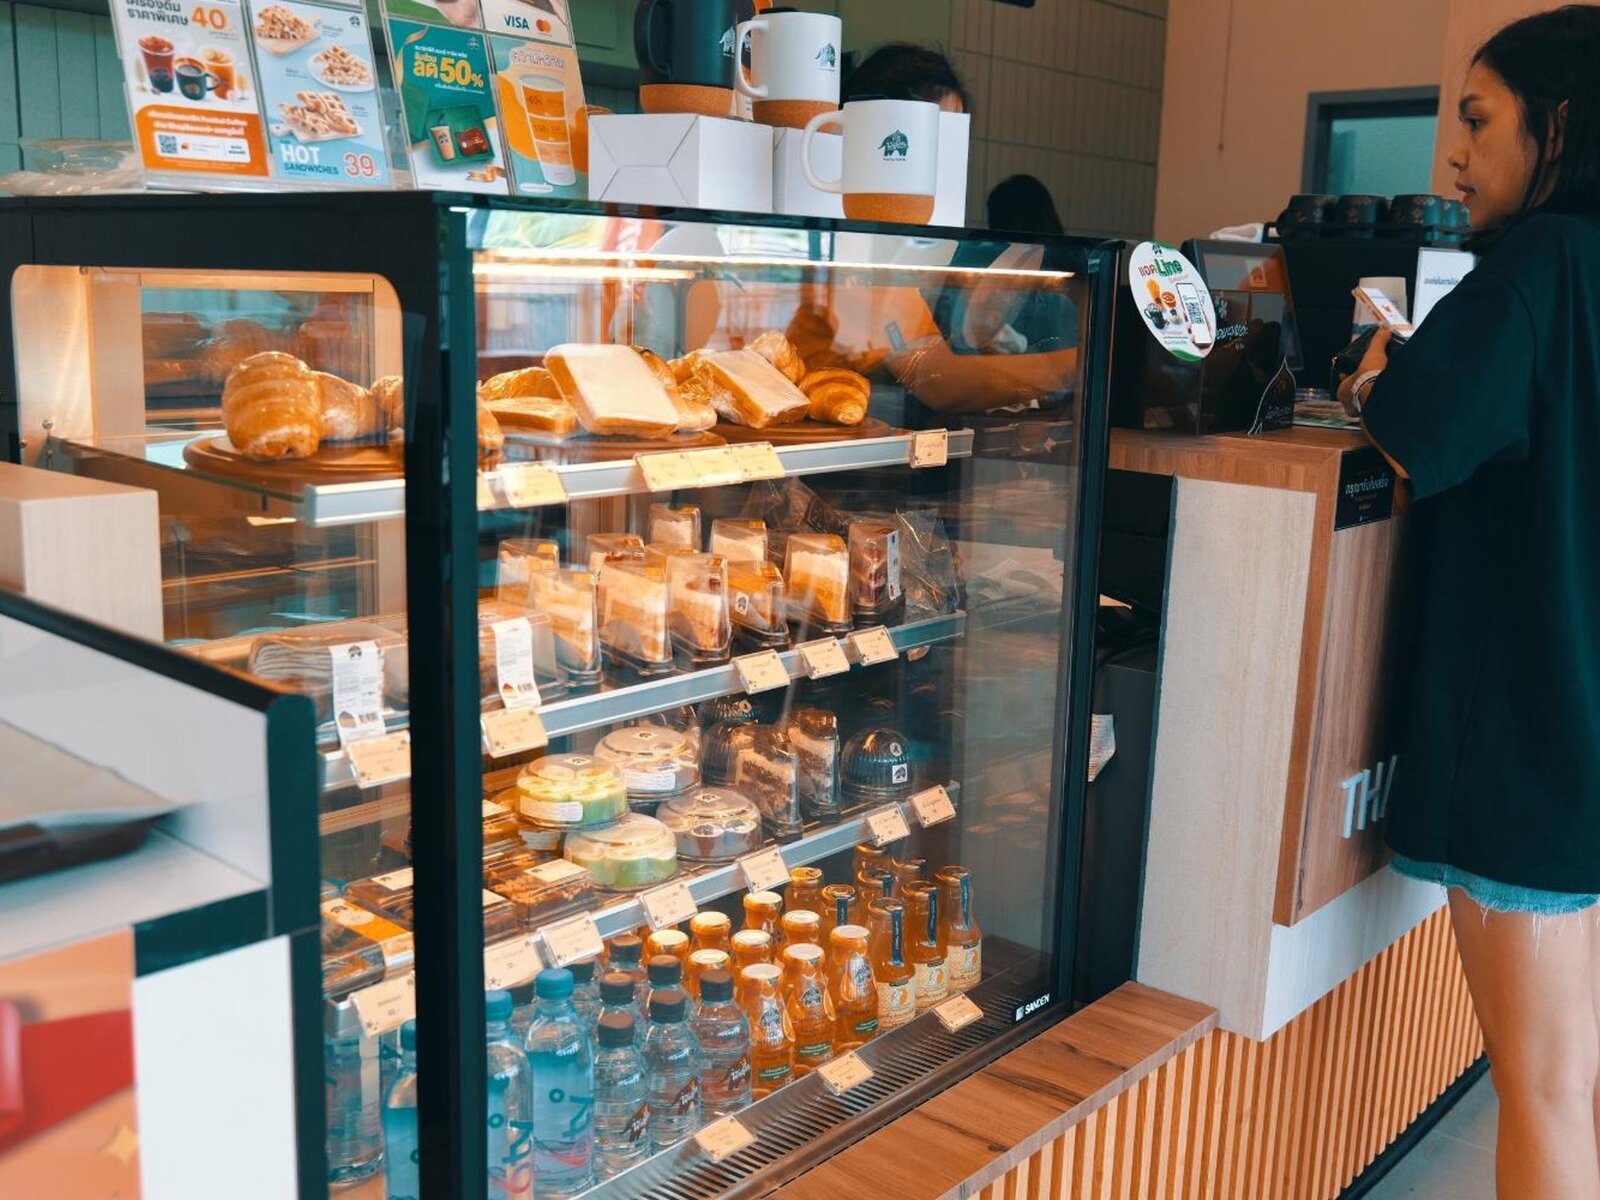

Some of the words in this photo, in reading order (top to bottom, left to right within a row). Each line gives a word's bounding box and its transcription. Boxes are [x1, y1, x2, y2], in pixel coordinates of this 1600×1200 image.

[127, 9, 189, 26] ราคาพิเศษ
[192, 5, 227, 30] 40
[504, 15, 530, 30] VISA
[413, 60, 439, 79] ลด
[439, 57, 484, 88] 50%
[280, 144, 320, 165] HOT
[344, 153, 374, 177] 39
[284, 163, 339, 175] SANDWICHES
[1154, 258, 1183, 276] Line
[1025, 993, 1050, 1015] SANDEN
